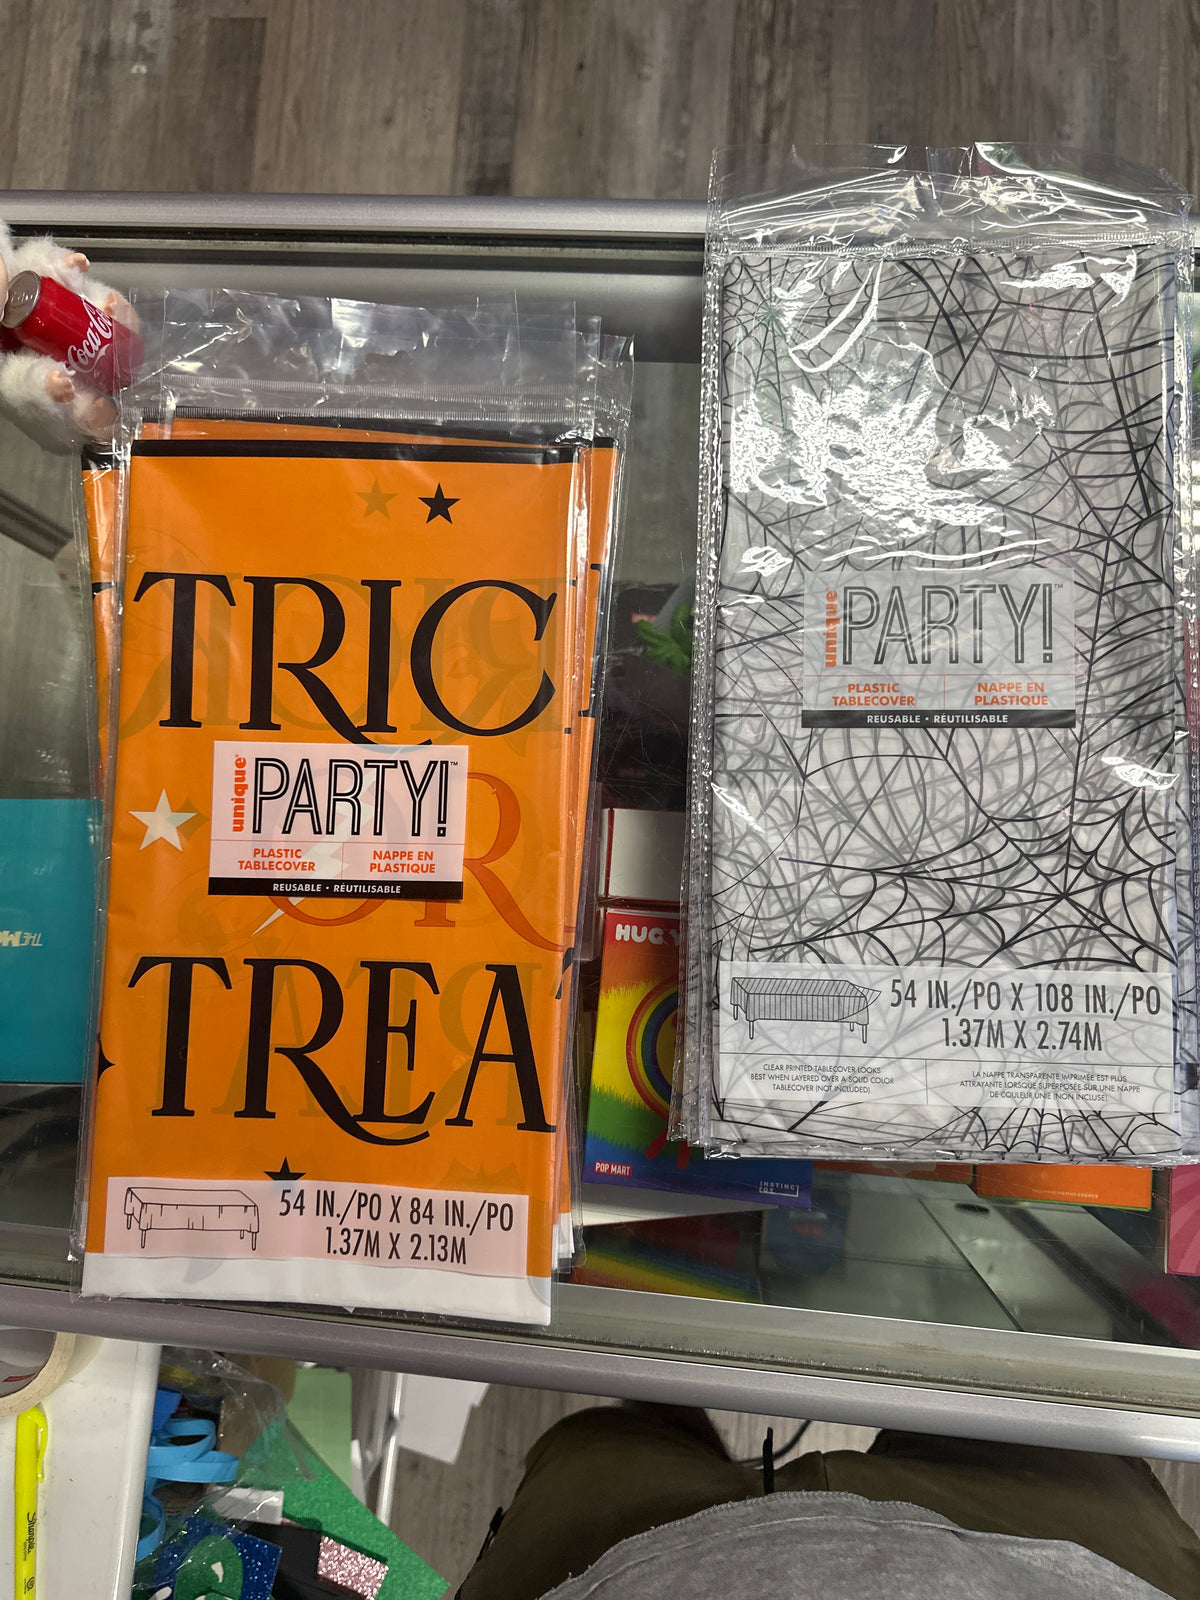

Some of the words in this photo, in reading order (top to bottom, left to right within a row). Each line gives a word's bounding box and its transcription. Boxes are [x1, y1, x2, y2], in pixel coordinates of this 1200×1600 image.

[848, 683, 900, 694] PLASTIC
[977, 682, 1023, 693] NAPPE
[1027, 682, 1045, 693] EN
[832, 695, 916, 706] TABLECOVER
[974, 695, 1048, 707] PLASTIQUE
[866, 714, 921, 724] REUSABLE
[933, 712, 1009, 724] RÉUTILISABLE
[253, 848, 303, 859] PLASTIC
[372, 850, 414, 862] NAPPE
[417, 851, 434, 862] EN
[238, 860, 316, 872] TABLECOVER
[369, 863, 436, 875] PLASTIQUE
[272, 883, 322, 893] REUSABLE
[333, 881, 401, 894] RÉUTILISABLE
[890, 978, 917, 1008] 54
[927, 978, 1001, 1017] IN./PO
[1010, 982, 1024, 1011] X
[1035, 983, 1074, 1013] 108
[1085, 982, 1162, 1022] IN./PO
[942, 1017, 1005, 1049] 1.37M
[1014, 1020, 1027, 1049] X
[1037, 1020, 1102, 1052] 2.74M
[814, 1065, 856, 1073] TABLECOVER
[857, 1066, 882, 1074] LOOKS
[791, 1074, 820, 1082] LAYERED
[982, 1071, 1005, 1079] NAPPE
[1006, 1072, 1060, 1080] TRANSPARENTE
[1061, 1073, 1095, 1081] IMPRIMÉE
[772, 1083, 814, 1092] TABLECOVER
[815, 1084, 832, 1093] (NOT
[1004, 1081, 1037, 1089] LORSQUE
[1038, 1082, 1082, 1090] SUPERPOSÉE
[1100, 1084, 1115, 1092] UNE
[1117, 1085, 1141, 1093] NAPPE
[1000, 1091, 1033, 1099] COULEUR
[1034, 1092, 1052, 1100] UNIE
[1053, 1092, 1074, 1101] (NON
[595, 1162, 610, 1173] POP
[610, 1163, 631, 1176] MART
[279, 1188, 306, 1217] 54
[315, 1189, 382, 1226] IN./PO
[389, 1194, 402, 1223] X
[409, 1197, 435, 1225] 84
[444, 1199, 514, 1236] IN./PO
[325, 1226, 381, 1258] 1.37M
[388, 1231, 401, 1260] X
[410, 1233, 467, 1265] 2.13M
[26, 1511, 37, 1554] Sharpie
